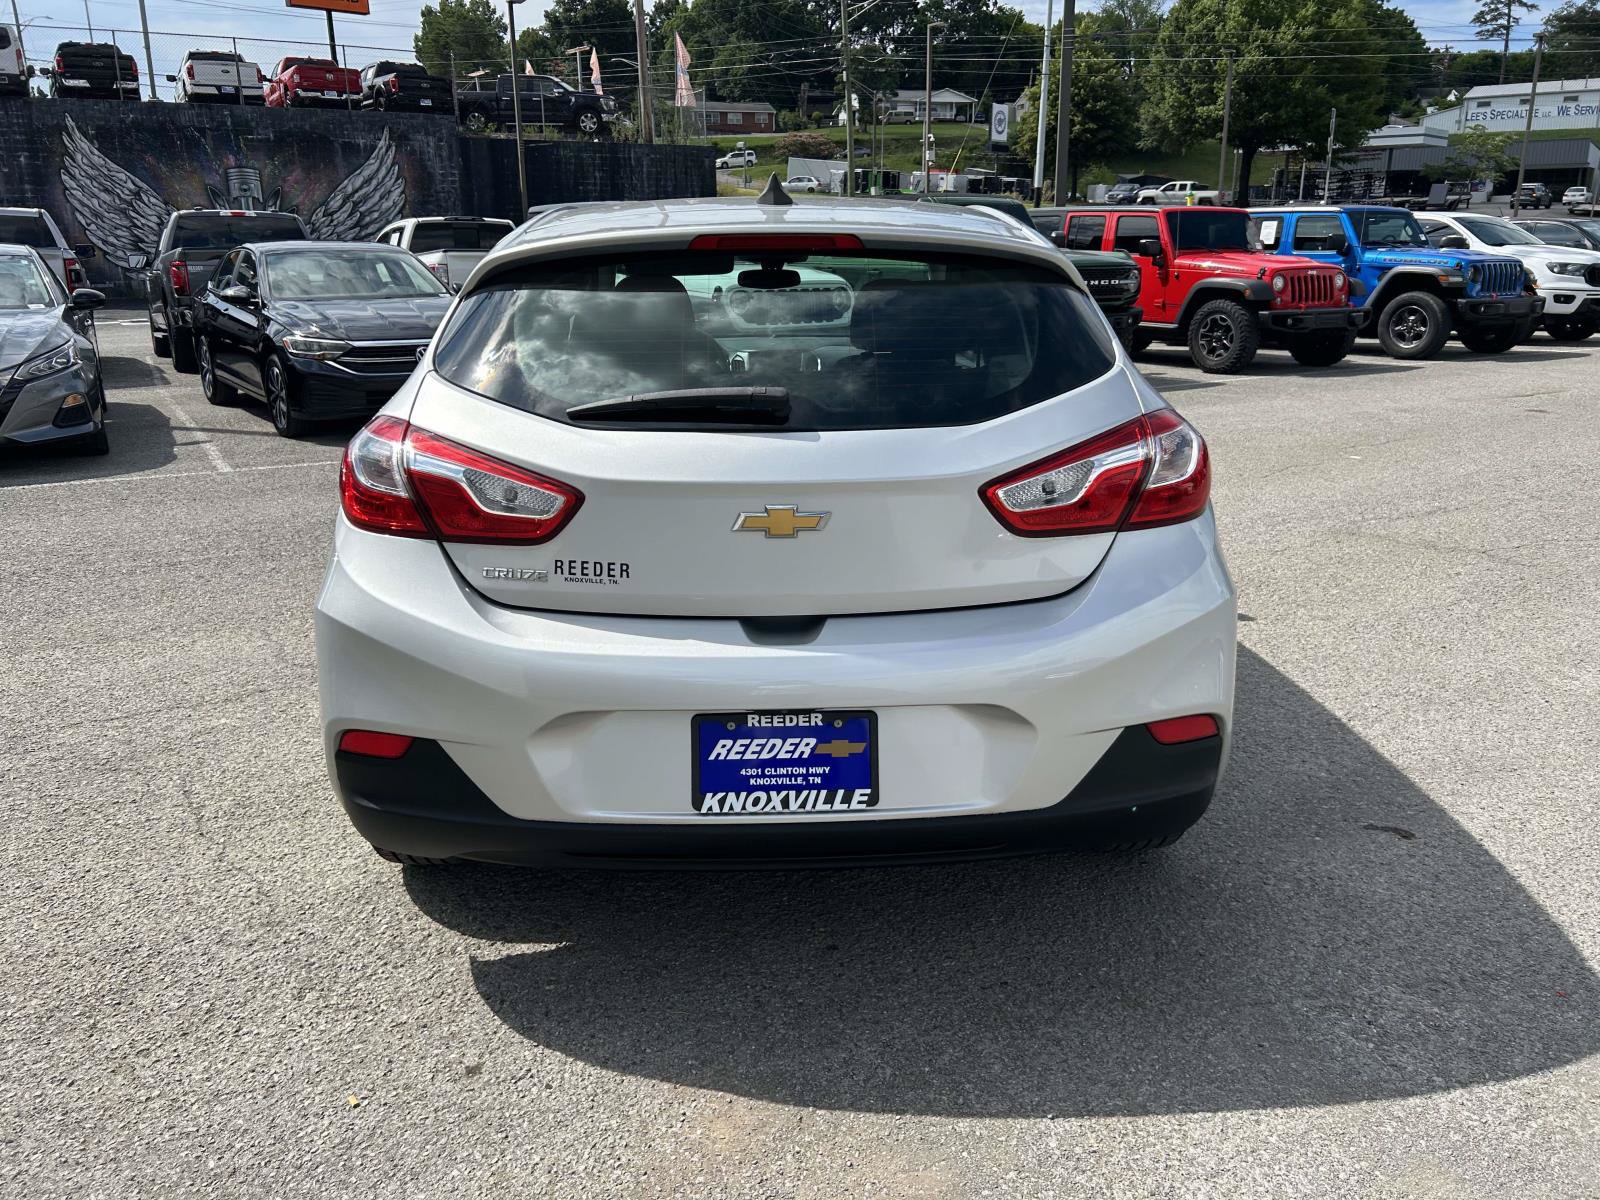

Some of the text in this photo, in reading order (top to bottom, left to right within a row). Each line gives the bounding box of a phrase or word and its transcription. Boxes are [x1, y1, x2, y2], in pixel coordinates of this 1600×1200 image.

[1465, 111, 1488, 121] LEE'S
[1489, 108, 1540, 120] SPECIALTE
[1557, 105, 1572, 116] WE
[482, 566, 549, 582] CRUZE
[553, 559, 630, 579] REEDER
[564, 576, 607, 585] KNOXVILLE,
[747, 713, 824, 727] REEDER
[708, 737, 817, 760] REEDER
[740, 766, 831, 776] 4301 CLINTON HWY
[749, 776, 822, 786] KNOXVILLE, TN
[700, 789, 872, 814] KNOXVILLE
